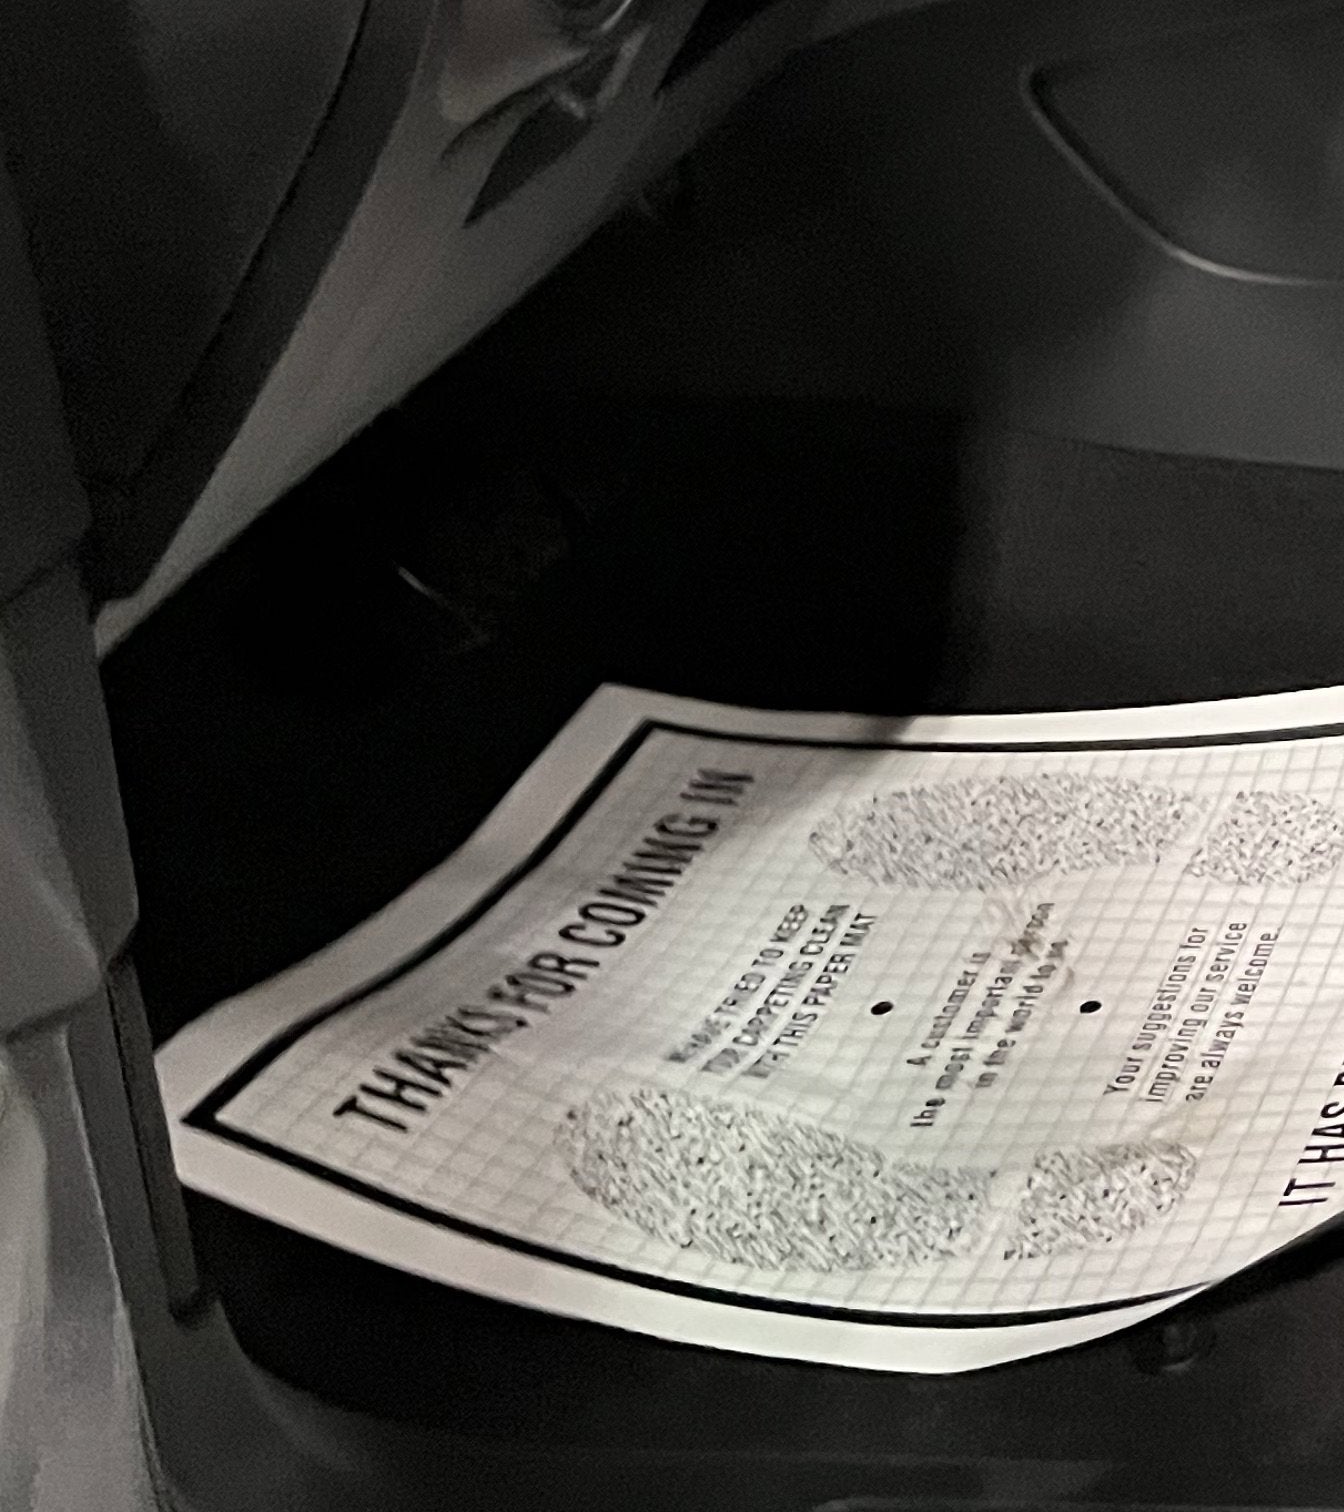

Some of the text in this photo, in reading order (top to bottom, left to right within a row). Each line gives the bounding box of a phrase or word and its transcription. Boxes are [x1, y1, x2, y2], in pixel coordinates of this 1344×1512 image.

[333, 768, 755, 1133] THANKS FOR COMING IN
[751, 948, 784, 967] TO
[772, 1012, 818, 1046] THIS
[801, 953, 857, 1006] PAPER
[839, 913, 878, 947] MAT
[921, 971, 978, 1049] customer
[1103, 927, 1208, 1095] Your suggestions for
[1144, 922, 1247, 1102] improving our service
[910, 1097, 946, 1127] the
[935, 1047, 973, 1089] most
[961, 960, 1021, 1039] important
[1185, 1075, 1213, 1102] are
[1201, 1011, 1244, 1069] always
[1279, 1177, 1336, 1207] IT
